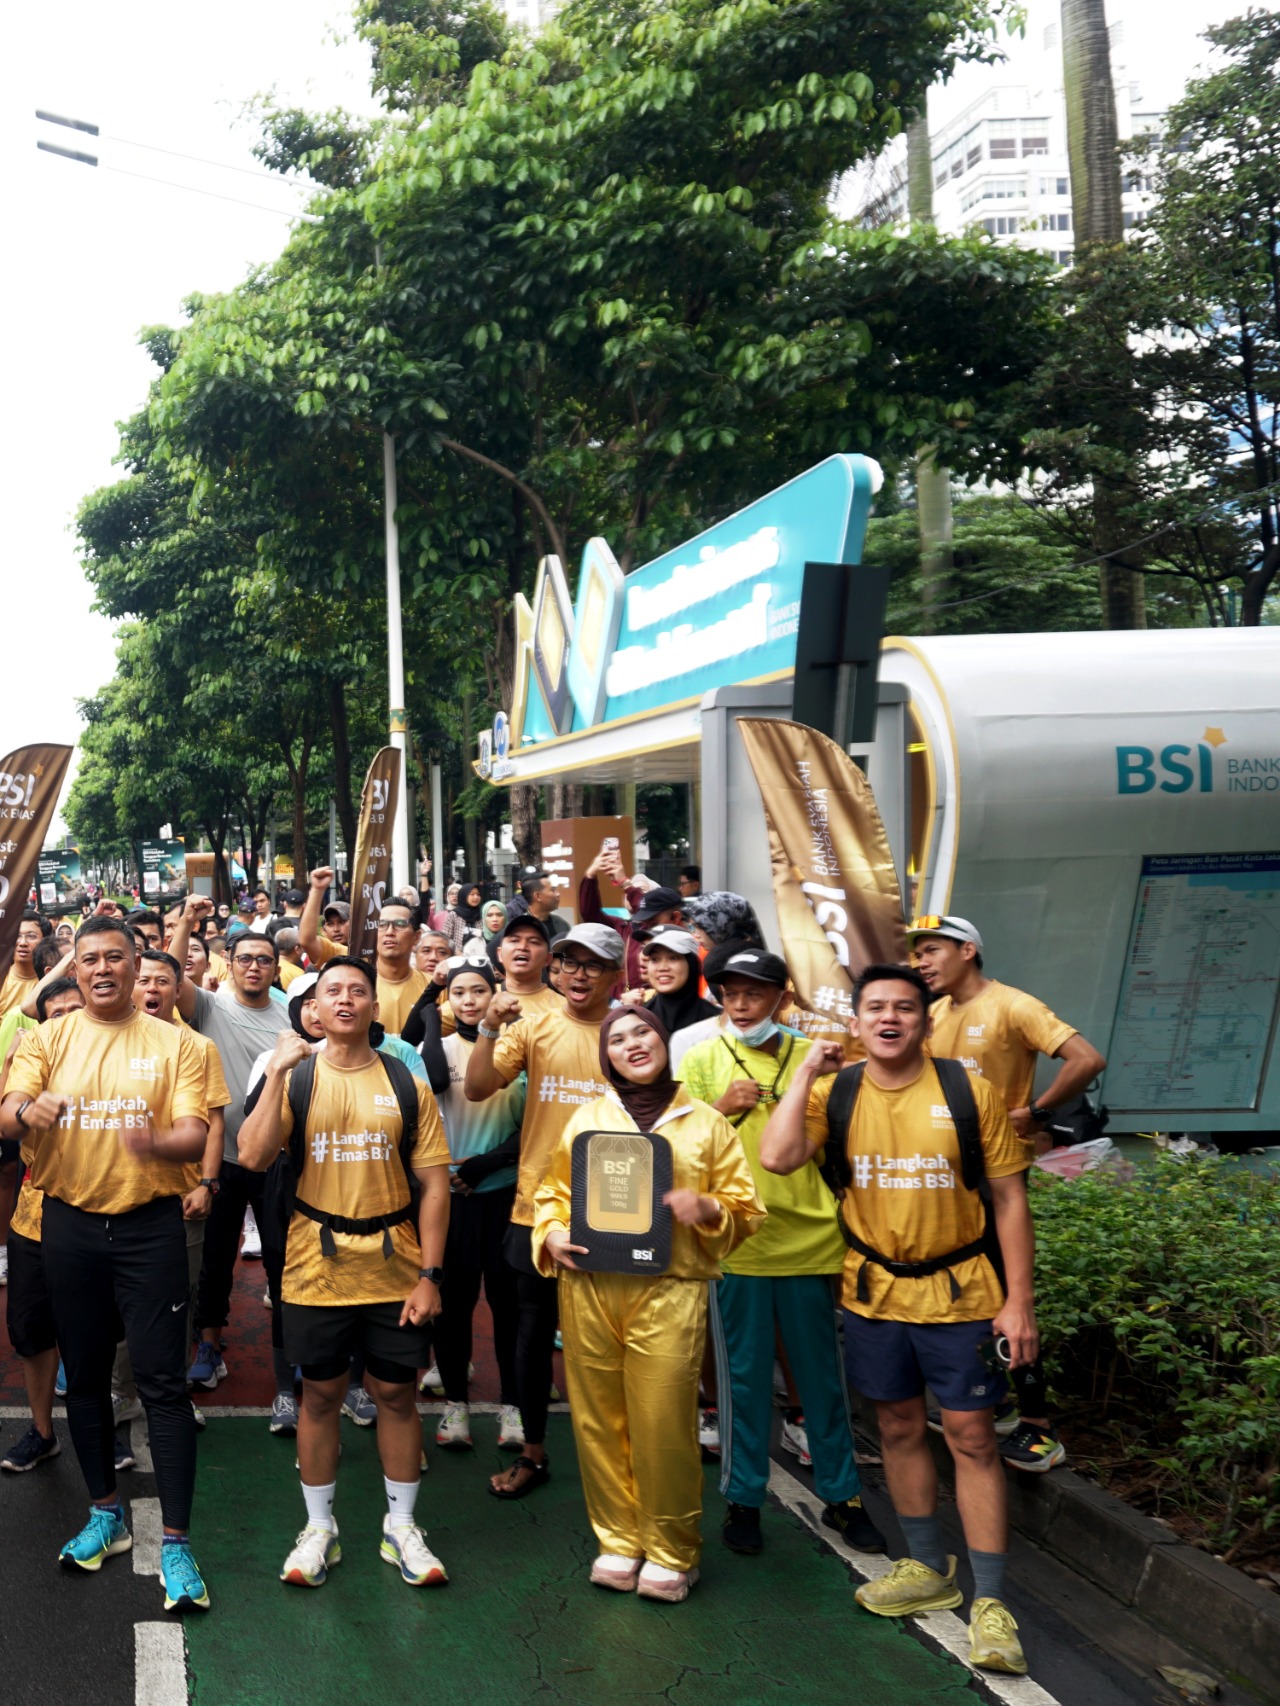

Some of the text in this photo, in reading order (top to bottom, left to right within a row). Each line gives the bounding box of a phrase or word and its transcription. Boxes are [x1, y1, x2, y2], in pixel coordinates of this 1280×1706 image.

[1116, 743, 1213, 794] BSI
[814, 788, 841, 877] INDONESIA
[812, 830, 829, 877] BANK
[130, 1057, 155, 1070] BSI
[80, 1095, 147, 1114] Langkah
[373, 1094, 397, 1107] BSI
[80, 1114, 122, 1130] Emas
[332, 1128, 388, 1146] Langkah
[332, 1147, 370, 1163] Emas
[876, 1153, 950, 1173] Langkah
[603, 1160, 631, 1176] BSI
[609, 1176, 629, 1186] FINE
[877, 1172, 956, 1189] Emas BSI
[609, 1185, 629, 1193] GOLD
[611, 1200, 627, 1210] 100g
[632, 1248, 653, 1261] BSI
